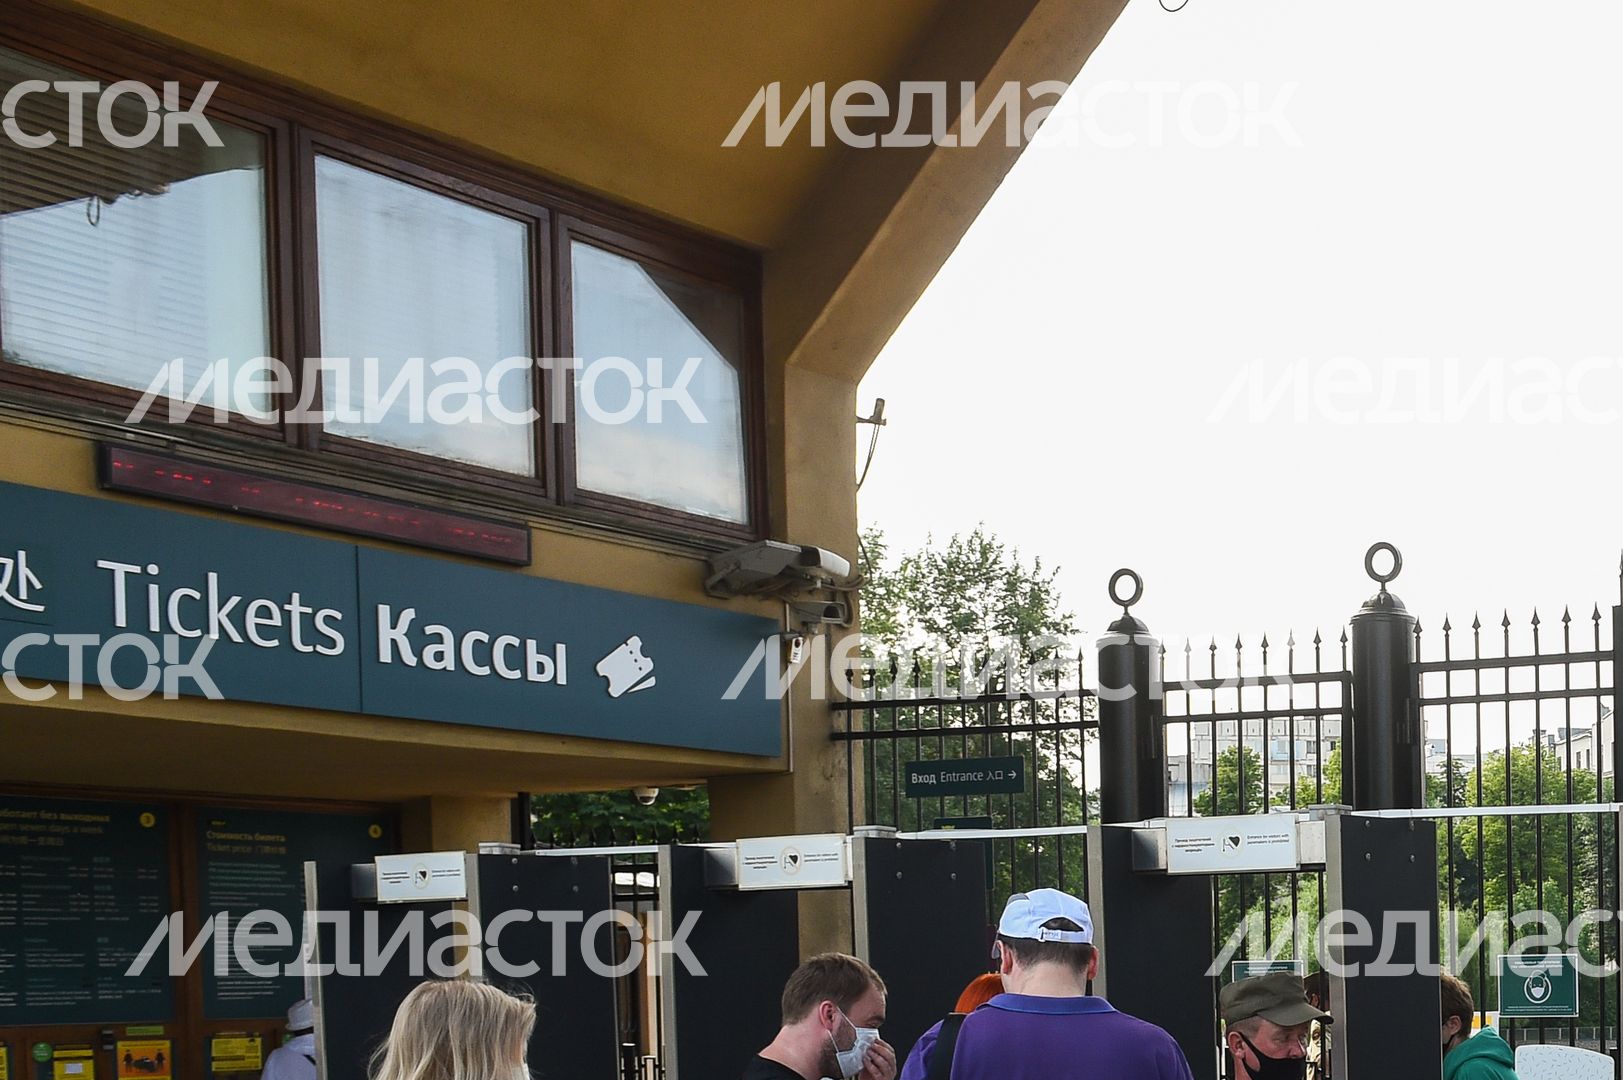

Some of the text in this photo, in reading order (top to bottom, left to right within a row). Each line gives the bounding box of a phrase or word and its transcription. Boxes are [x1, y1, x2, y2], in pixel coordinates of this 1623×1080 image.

[96, 559, 346, 656] Tickets
[377, 603, 568, 685] Кассы
[911, 770, 1004, 785] Вход Entrance 入口
